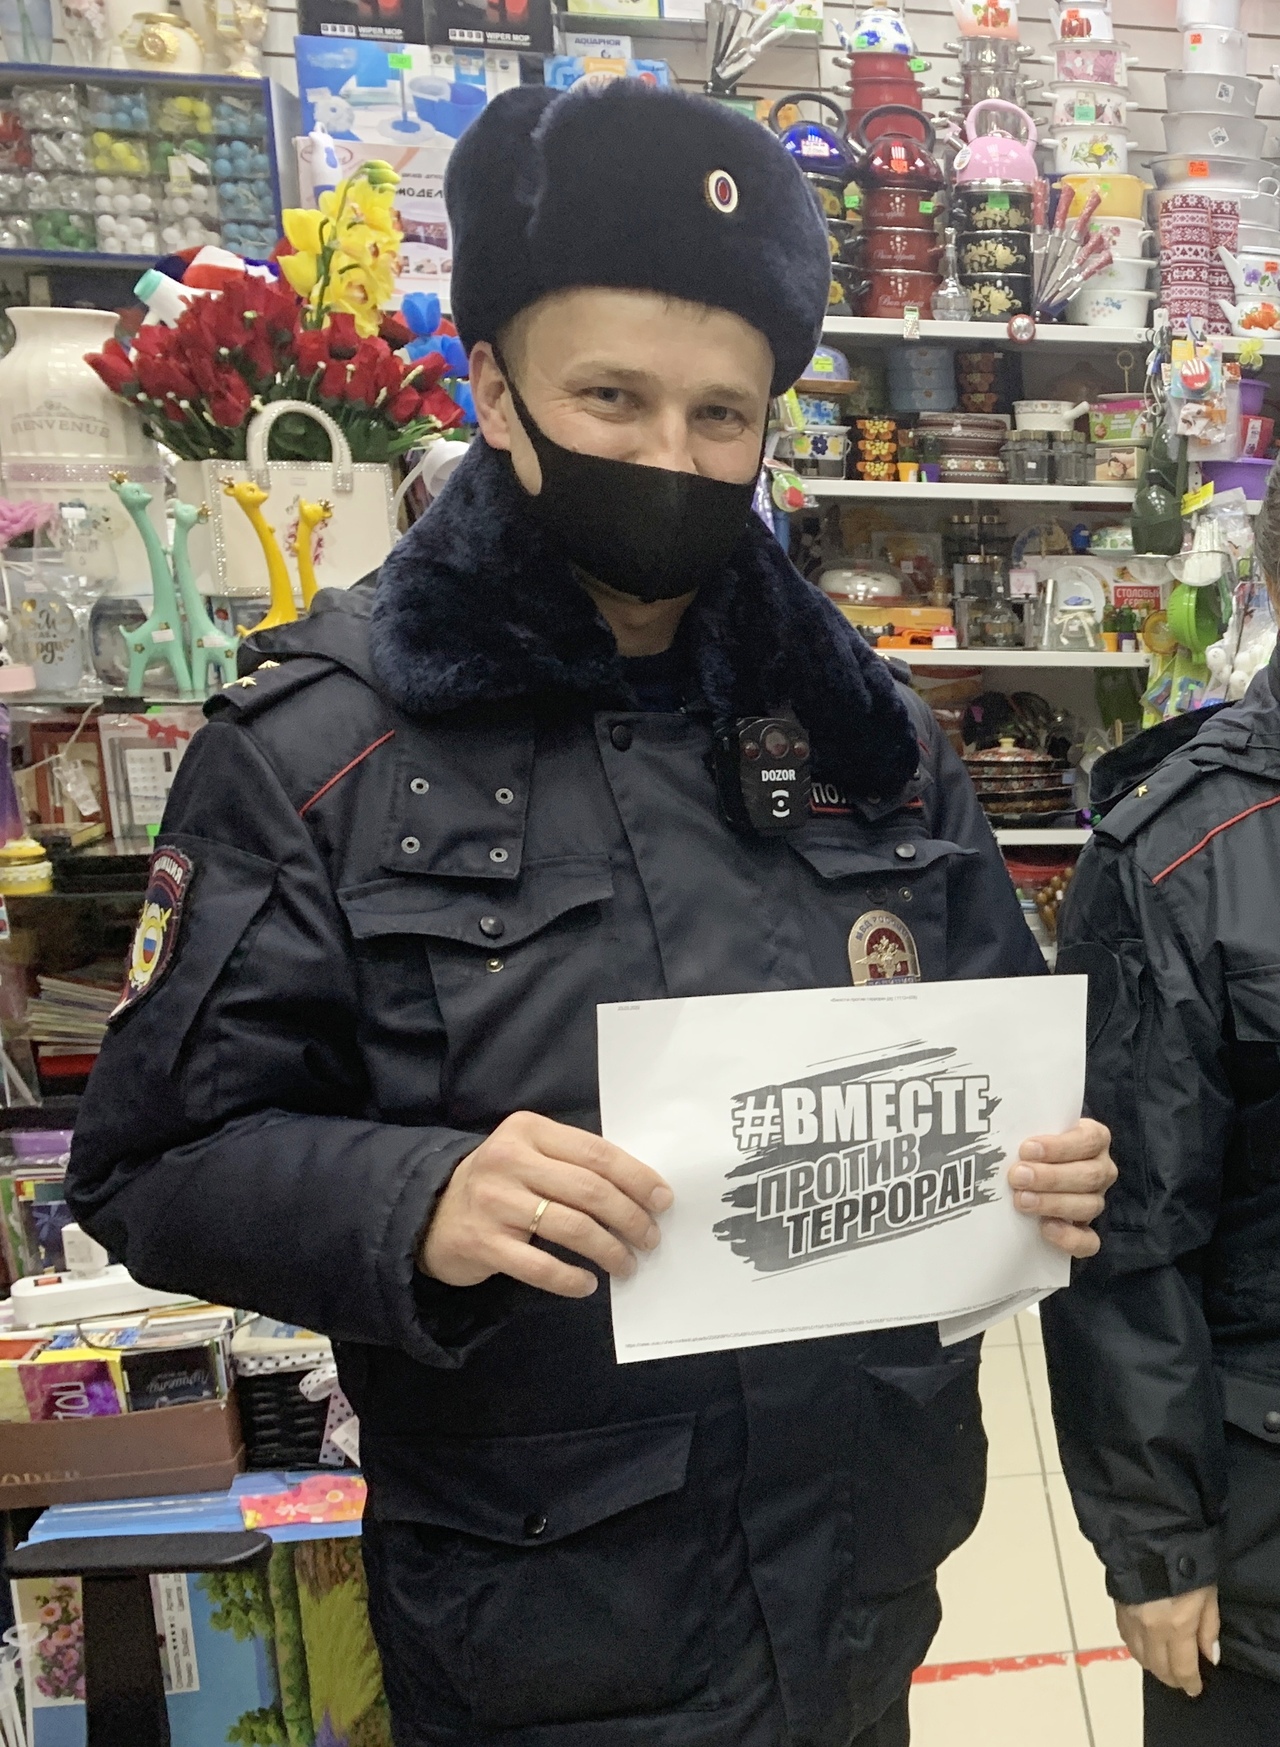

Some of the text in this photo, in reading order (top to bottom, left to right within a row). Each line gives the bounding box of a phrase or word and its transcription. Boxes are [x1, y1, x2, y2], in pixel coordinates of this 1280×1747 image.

[358, 25, 384, 35] WIPER
[384, 27, 403, 36] MOP
[486, 31, 511, 40] WIPER
[512, 33, 530, 41] MOP
[574, 37, 621, 46] AQUAPHOR
[761, 769, 796, 782] DOZOR
[811, 782, 847, 804] ПО
[734, 1076, 990, 1150] #ВМЕСТЕ
[758, 1136, 919, 1220] ПРОТИВ
[785, 1155, 977, 1257] ТЕРРОРА!
